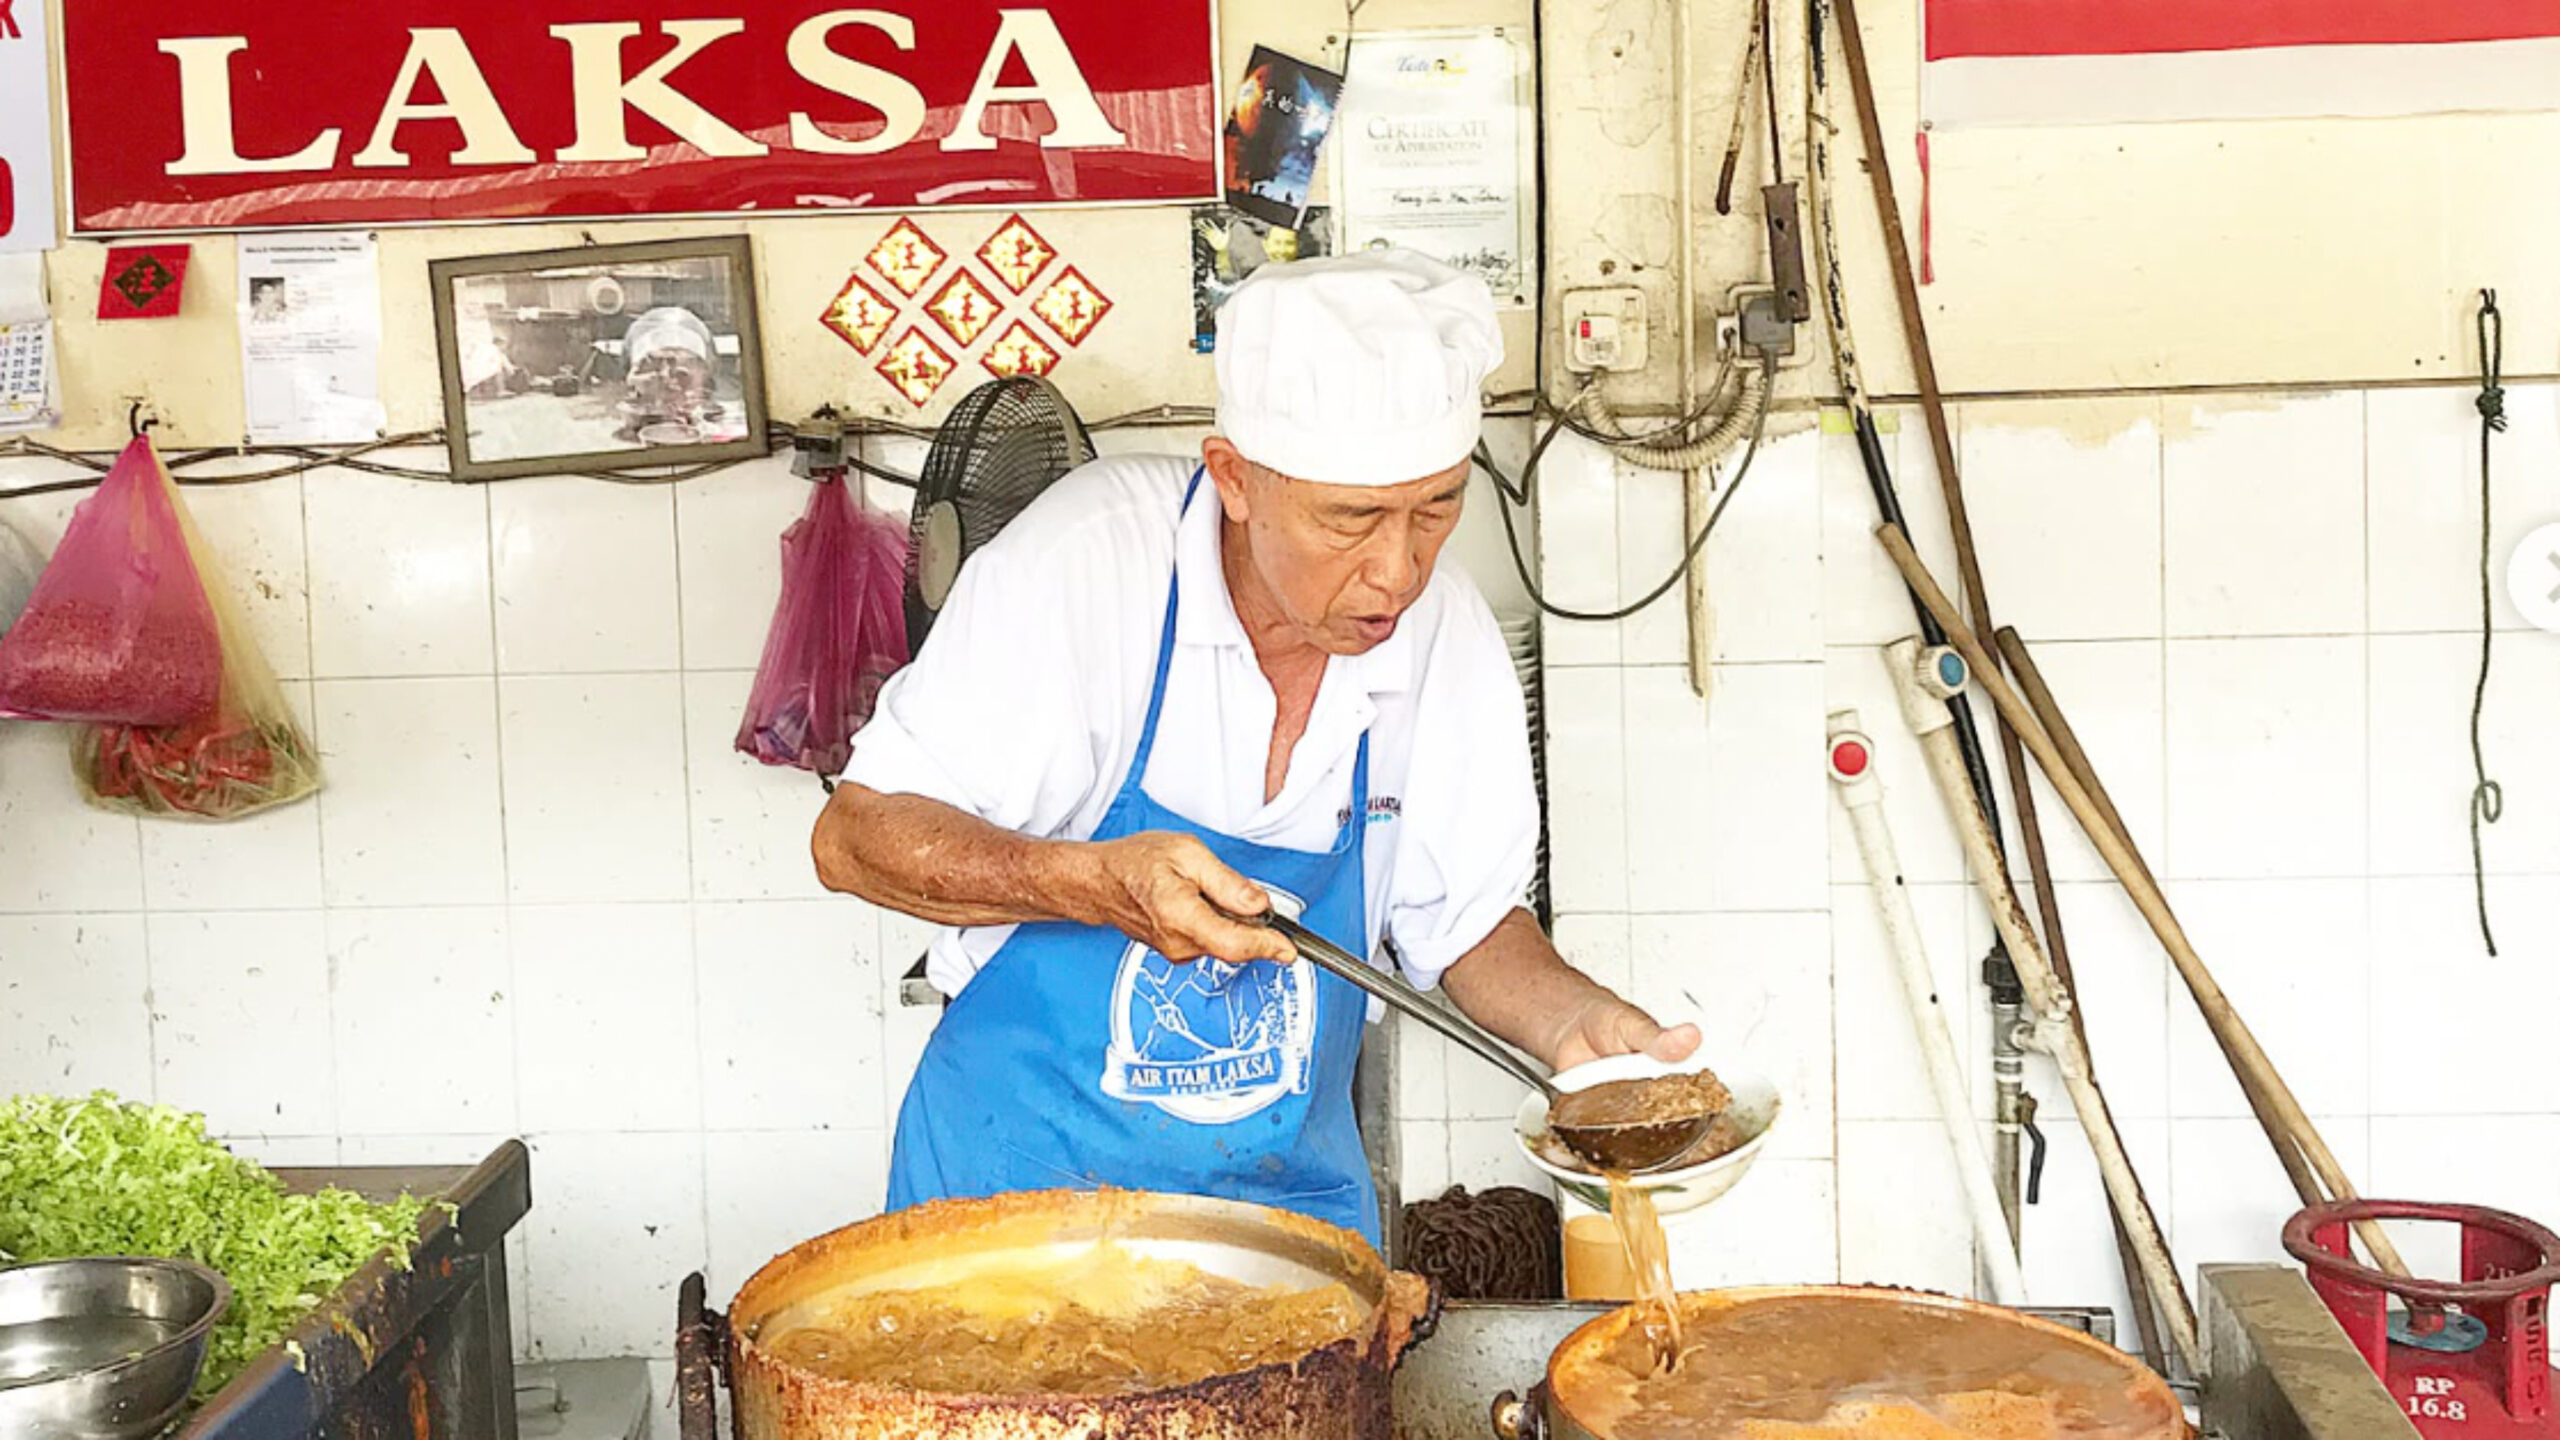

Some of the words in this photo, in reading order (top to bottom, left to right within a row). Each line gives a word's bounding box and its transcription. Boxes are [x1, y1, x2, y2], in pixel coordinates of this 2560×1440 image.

[157, 8, 1125, 175] LAKSA
[1131, 1067, 1163, 1087] AIR
[1166, 1065, 1211, 1086] ITAM
[1214, 1051, 1275, 1085] LAKSA
[2414, 1375, 2456, 1396] RP
[2407, 1396, 2467, 1421] 16.8
